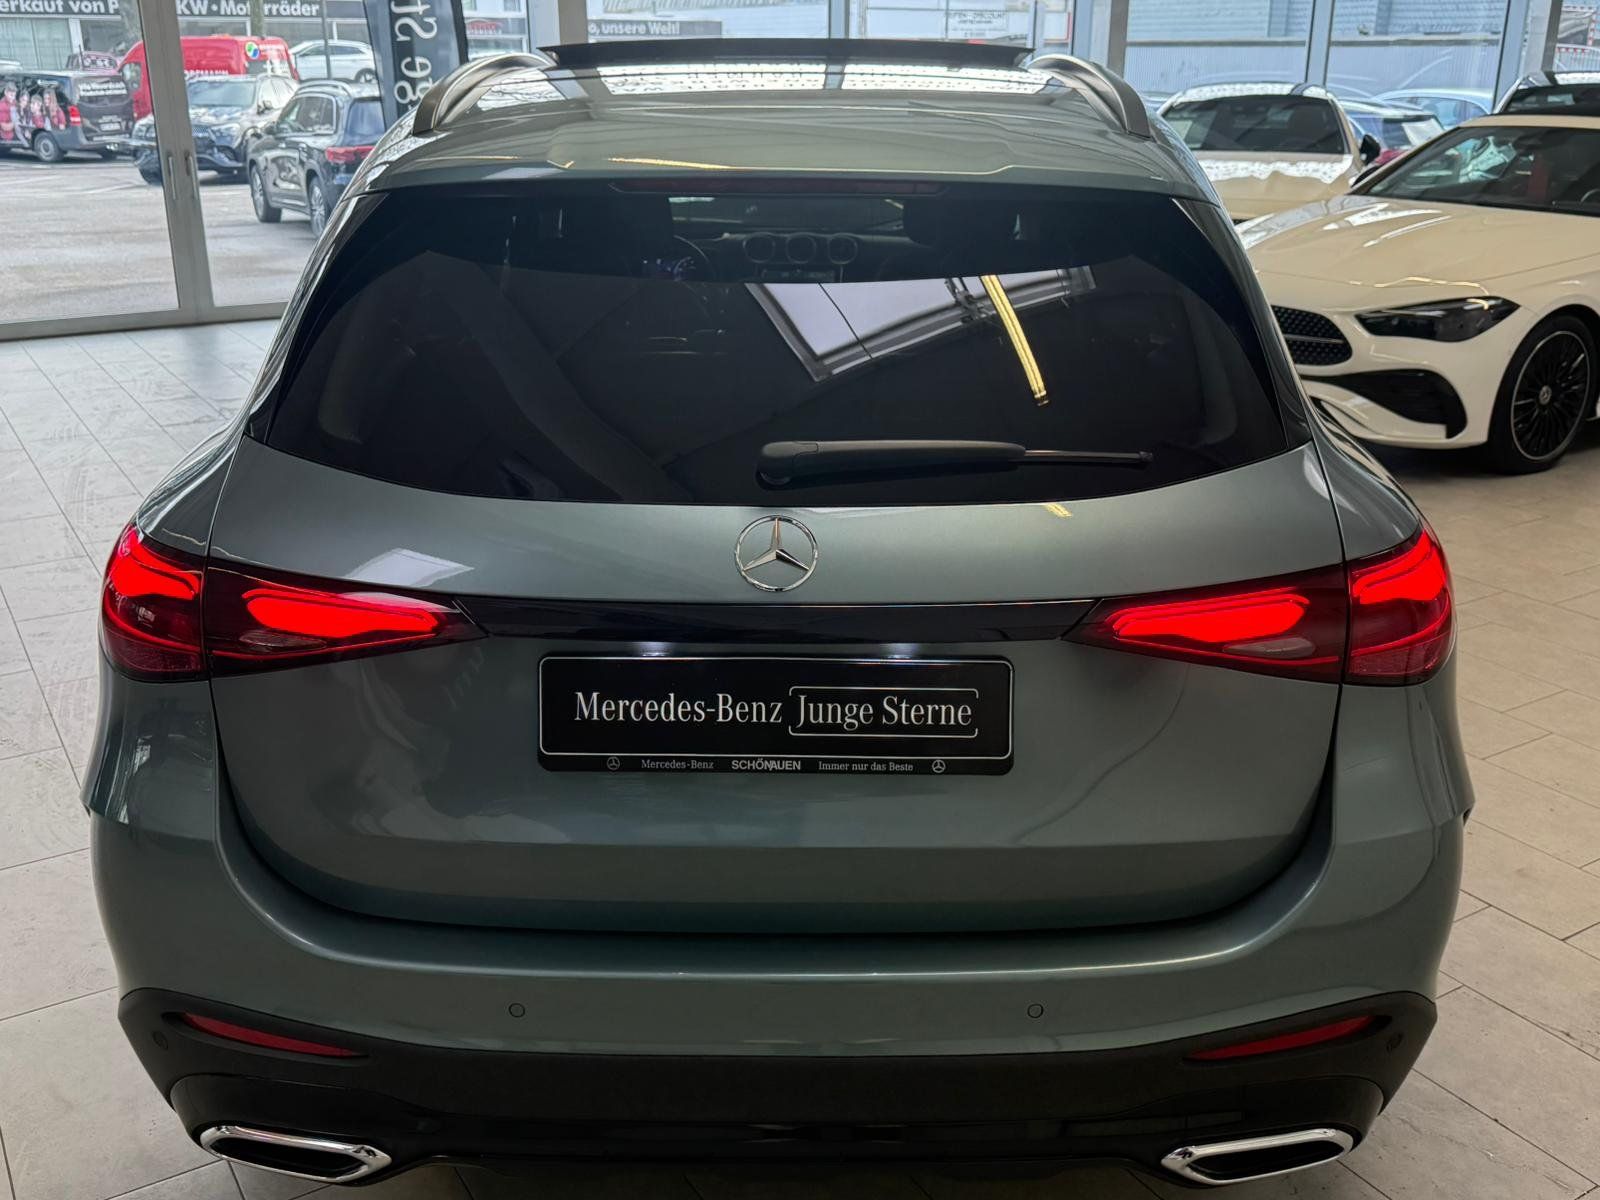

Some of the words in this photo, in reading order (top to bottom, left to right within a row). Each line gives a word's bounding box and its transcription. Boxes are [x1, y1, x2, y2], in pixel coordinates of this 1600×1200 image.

[69, 0, 106, 14] von
[220, 0, 320, 16] Motrräder
[602, 22, 646, 35] unsere
[648, 21, 680, 35] Welt!
[573, 690, 783, 724] Mercedes-Benz
[795, 693, 875, 731] Junge
[881, 695, 973, 726] Sterne
[641, 759, 715, 770] Mercedes-Benz
[731, 757, 802, 771] SCHÖNAUEN
[818, 760, 849, 771] Immer
[851, 763, 868, 771] nur
[870, 761, 887, 772] das
[889, 761, 914, 772] Beste
